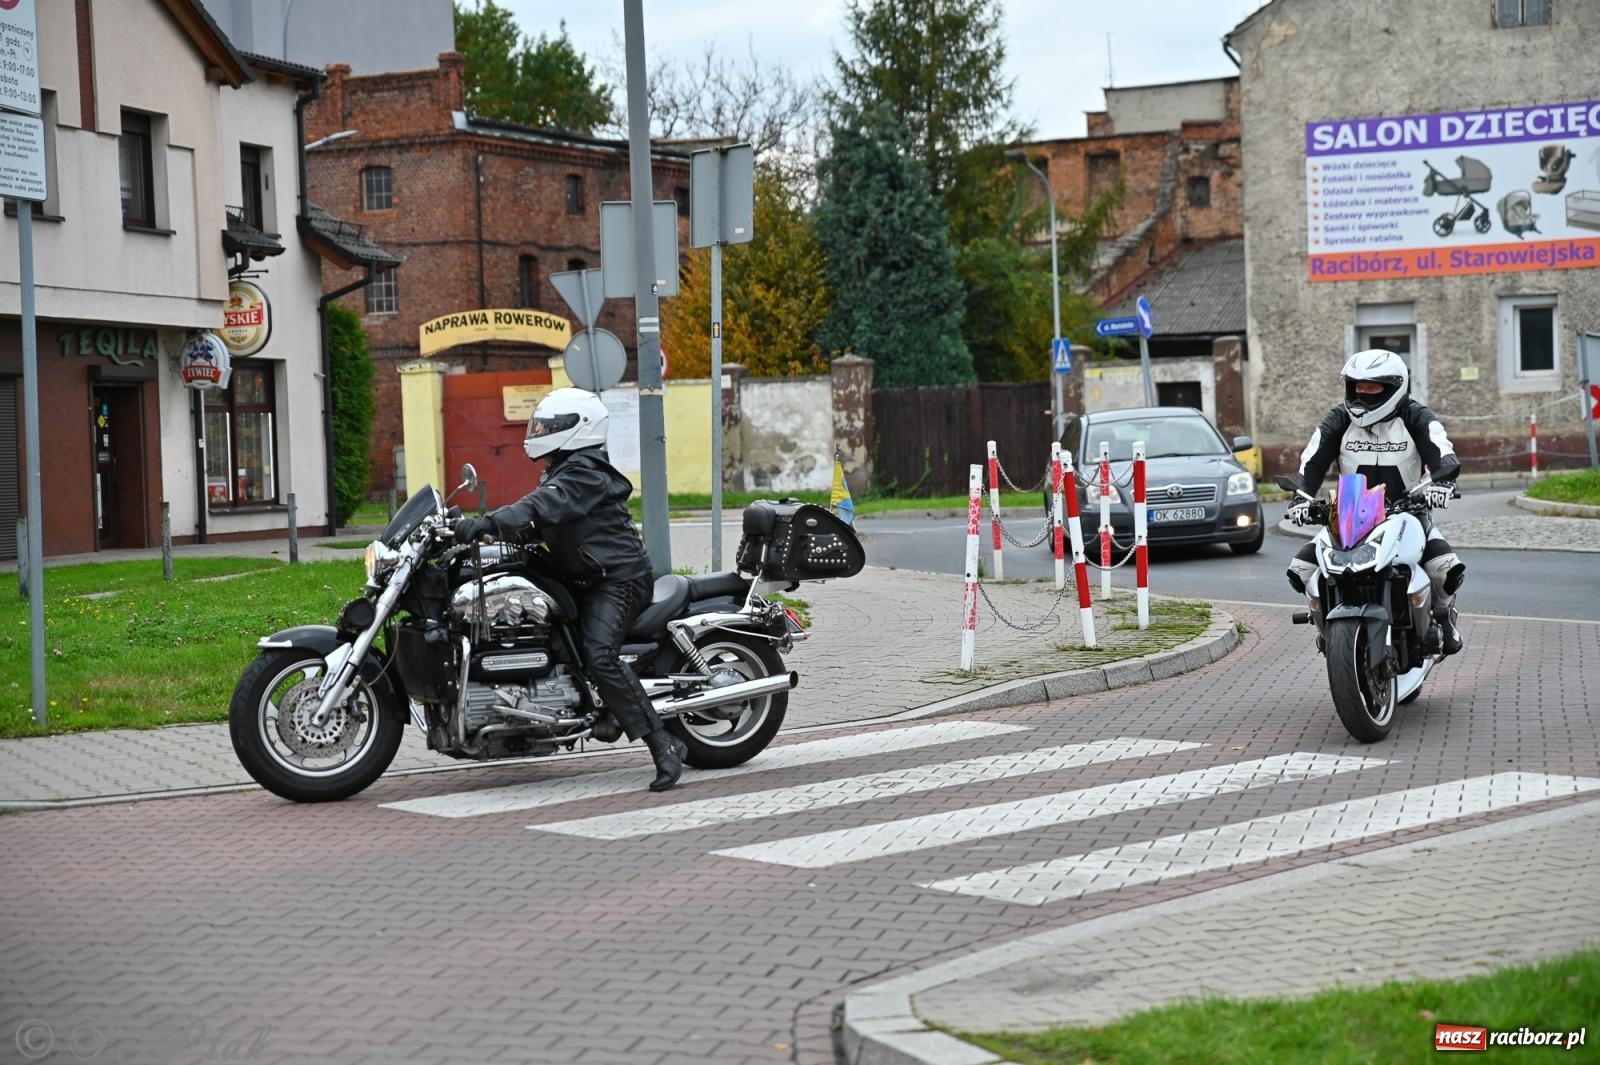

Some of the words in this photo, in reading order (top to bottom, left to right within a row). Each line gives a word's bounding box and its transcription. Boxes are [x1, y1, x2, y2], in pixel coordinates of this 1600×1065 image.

[1313, 119, 1428, 151] SALON
[1322, 162, 1351, 171] Wózki
[1353, 160, 1397, 169] dziecięce
[1322, 174, 1357, 183] Foteliki
[1365, 171, 1411, 181] nosidełka
[1322, 187, 1354, 196] Odzież
[1357, 184, 1414, 194] niemowlęca
[1374, 196, 1419, 205] materace
[1324, 211, 1363, 222] Zestawy
[1365, 207, 1429, 219] wyprawkowe
[1324, 223, 1350, 233] Sanki
[1358, 220, 1398, 232] śpiworki
[1324, 235, 1367, 246] Sprzedaż
[1369, 233, 1403, 242] ratalna
[1311, 251, 1409, 275] Racibórz,
[1417, 251, 1442, 270] ul.
[1450, 242, 1595, 270] Starowiejska
[424, 312, 489, 335] NAPRAWA
[494, 311, 565, 332] ROWERÓW
[60, 329, 157, 367] TEQILA
[1345, 440, 1408, 452] alpinestars
[1155, 510, 1169, 520] OK
[1173, 508, 1203, 520] 62880
